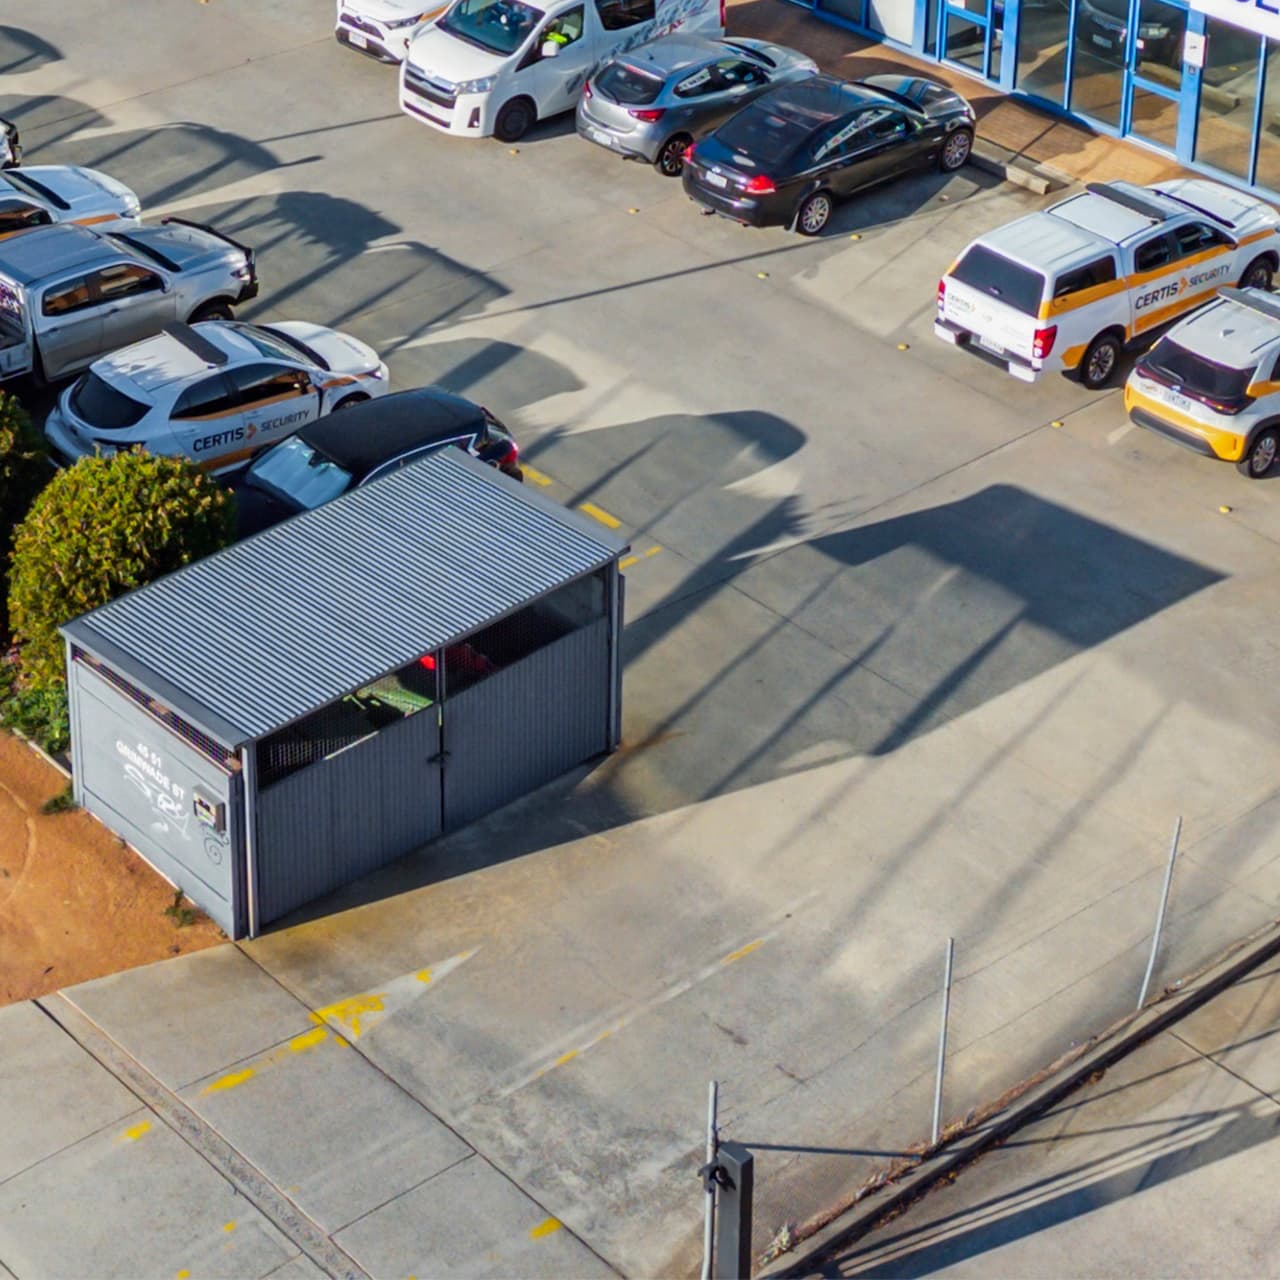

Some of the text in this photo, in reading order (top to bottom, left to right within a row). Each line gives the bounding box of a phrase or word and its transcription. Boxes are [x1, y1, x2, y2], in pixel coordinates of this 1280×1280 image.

[1135, 263, 1233, 310] CERTIS SECURITY
[193, 409, 309, 452] CERTIS SECURITY
